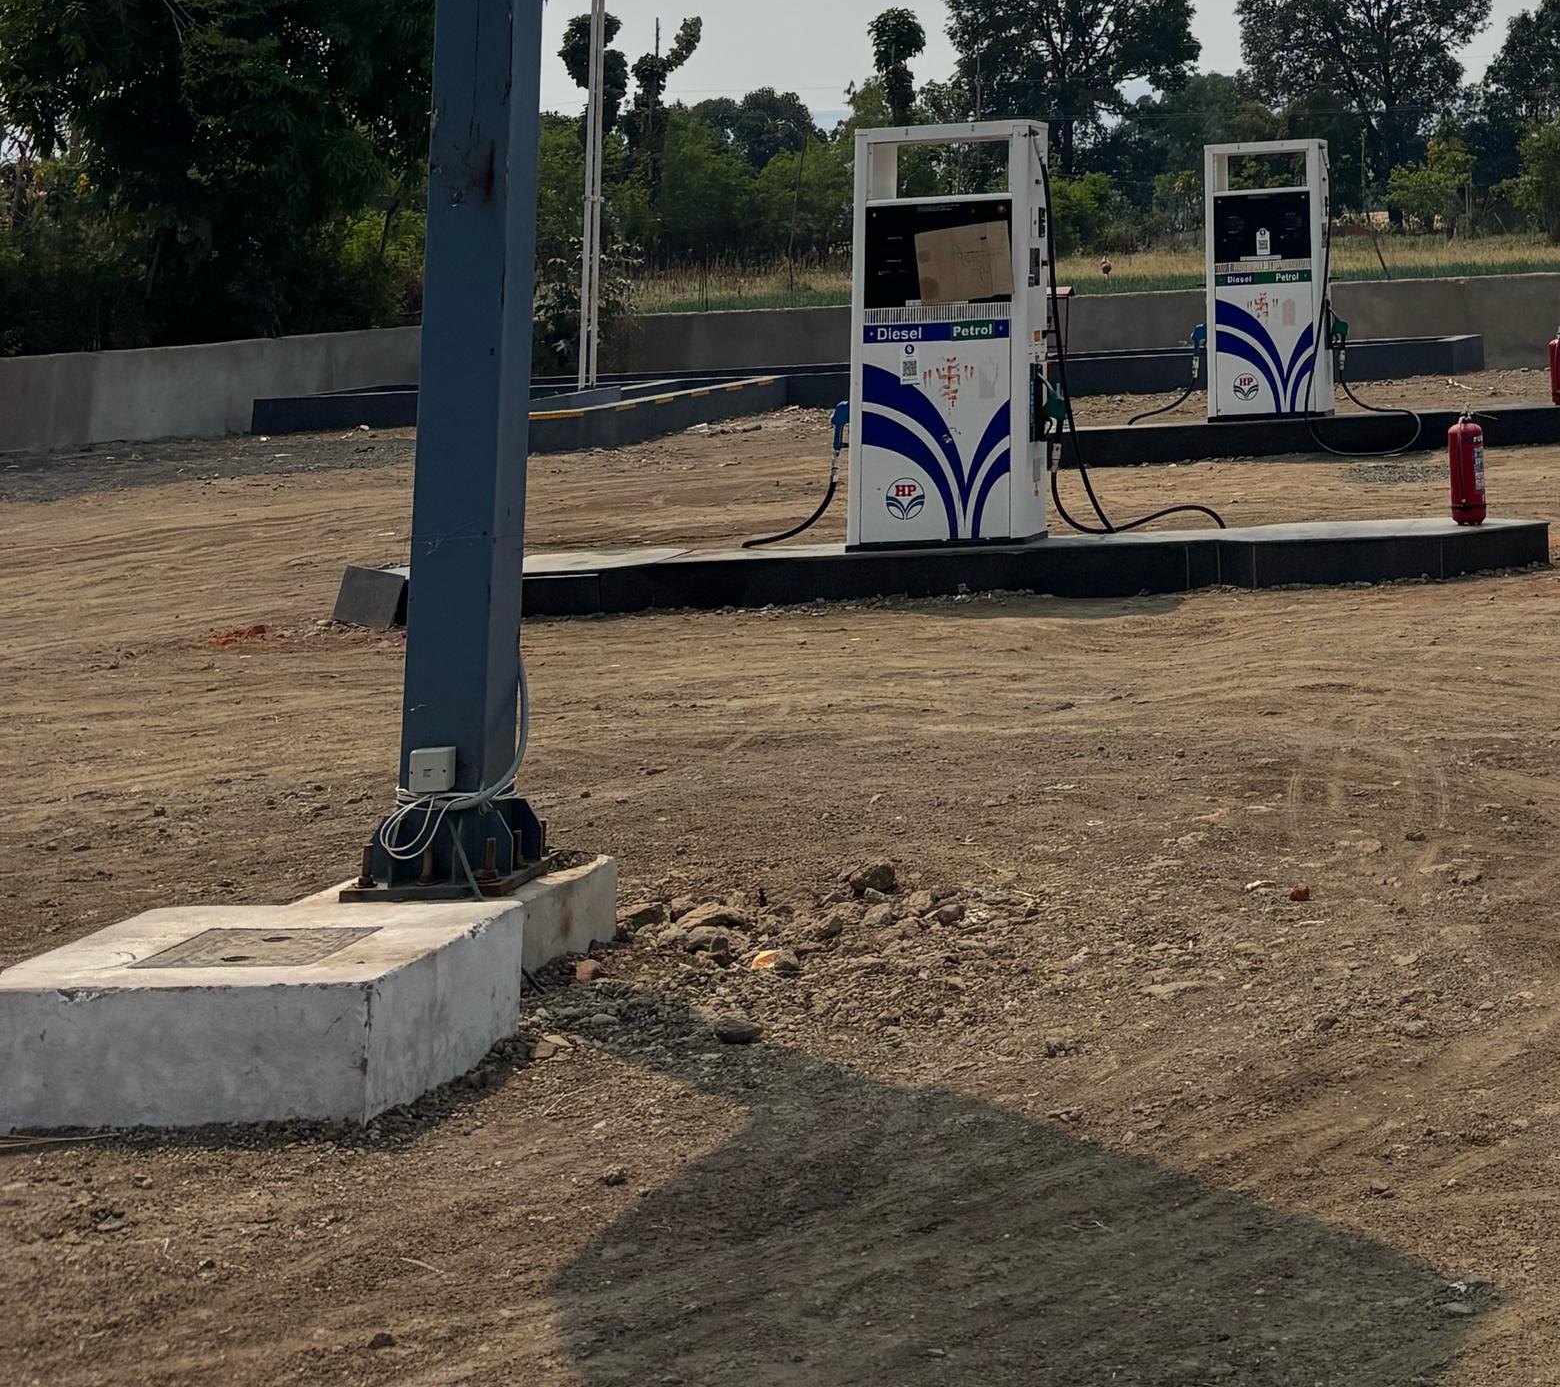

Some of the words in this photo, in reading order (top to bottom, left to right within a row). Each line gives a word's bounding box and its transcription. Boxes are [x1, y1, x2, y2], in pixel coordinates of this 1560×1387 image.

[1227, 275, 1252, 284] Diesel
[1275, 272, 1299, 282] Petrol
[877, 326, 922, 341] Diesel
[953, 323, 993, 337] Petrol
[1239, 377, 1254, 387] HP
[894, 484, 917, 497] HP
